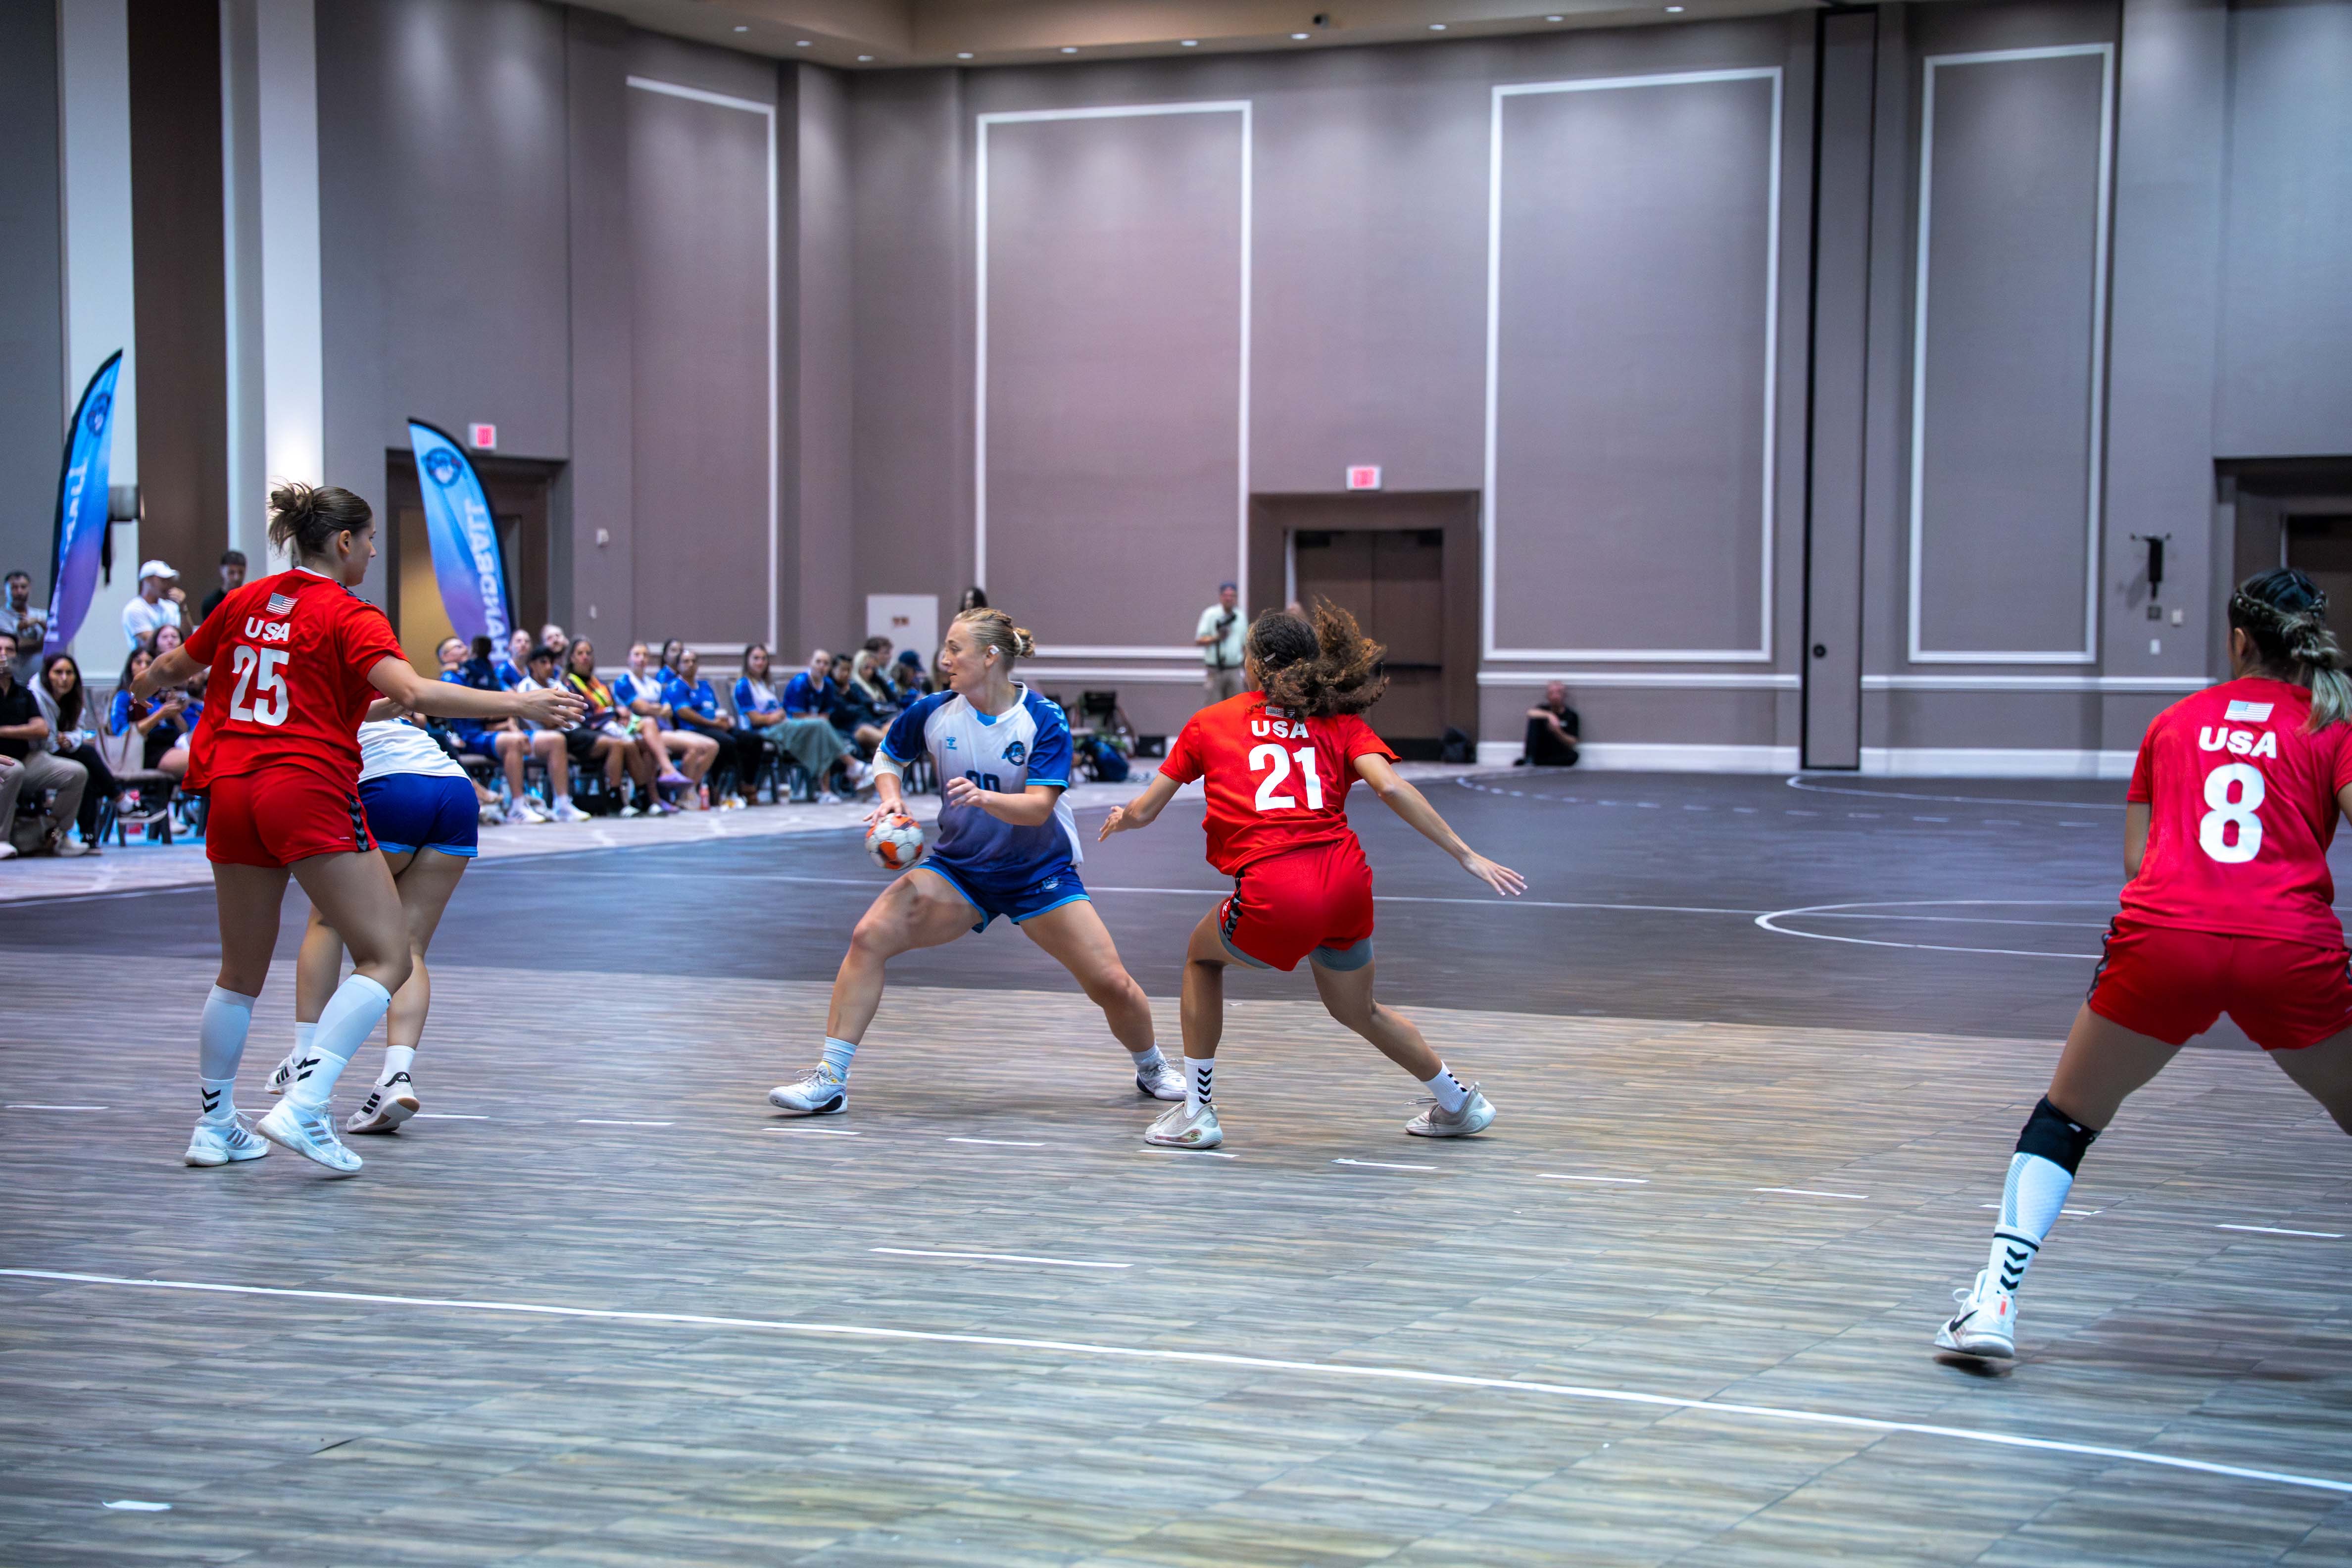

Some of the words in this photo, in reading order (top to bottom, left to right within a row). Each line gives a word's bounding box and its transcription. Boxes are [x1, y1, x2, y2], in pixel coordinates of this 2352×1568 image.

[245, 617, 291, 641] USA
[230, 645, 290, 726] 25
[1251, 720, 1309, 738] USA
[2199, 726, 2277, 759] USA
[1248, 743, 1323, 811] 21
[2199, 762, 2265, 863] 8
